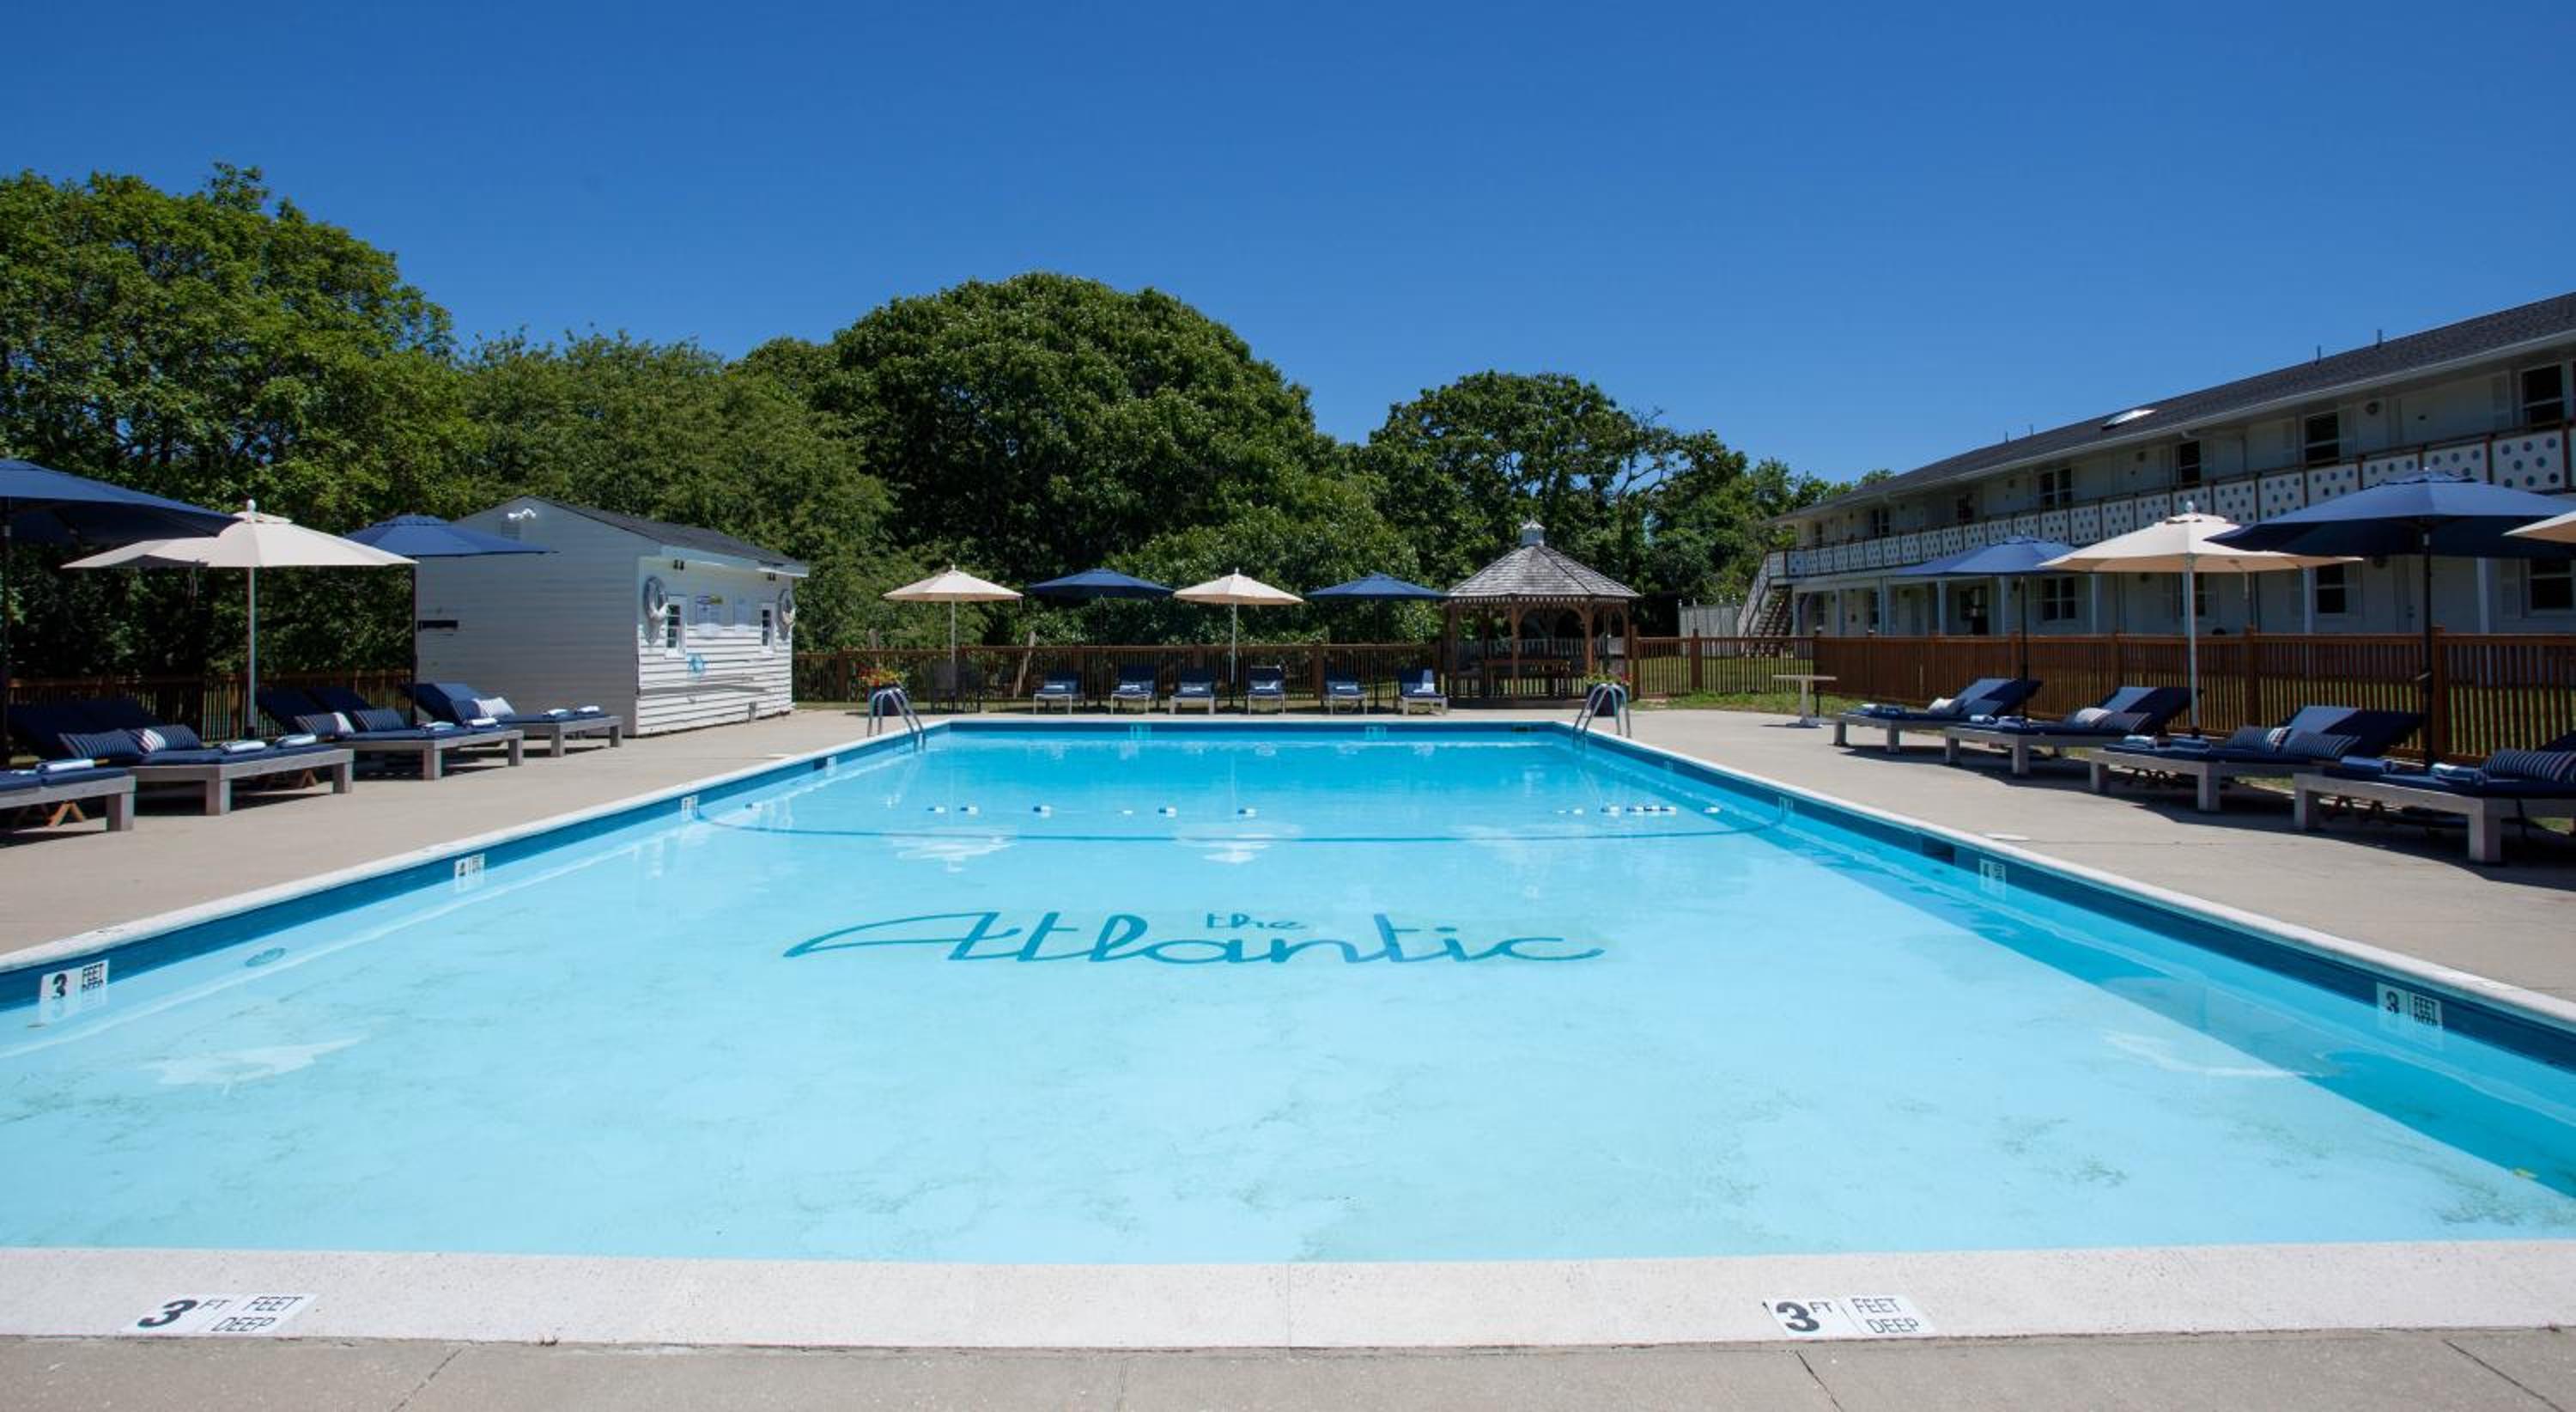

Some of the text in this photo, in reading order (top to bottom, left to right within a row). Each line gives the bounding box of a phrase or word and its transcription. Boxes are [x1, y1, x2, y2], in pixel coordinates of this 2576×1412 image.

[1206, 913, 1308, 930] the
[783, 911, 1605, 965] Atlantic
[82, 963, 104, 982] FEET
[52, 973, 67, 999] 3
[2386, 990, 2399, 1014] 3
[2412, 995, 2436, 1016] FEET
[137, 1299, 232, 1328] 3 FT
[242, 1296, 303, 1312] FEET
[1850, 1298, 1901, 1313] FEET
[211, 1317, 276, 1331] DEEP
[1776, 1301, 1832, 1332] 3 FT
[1865, 1318, 1919, 1333] DEEP
